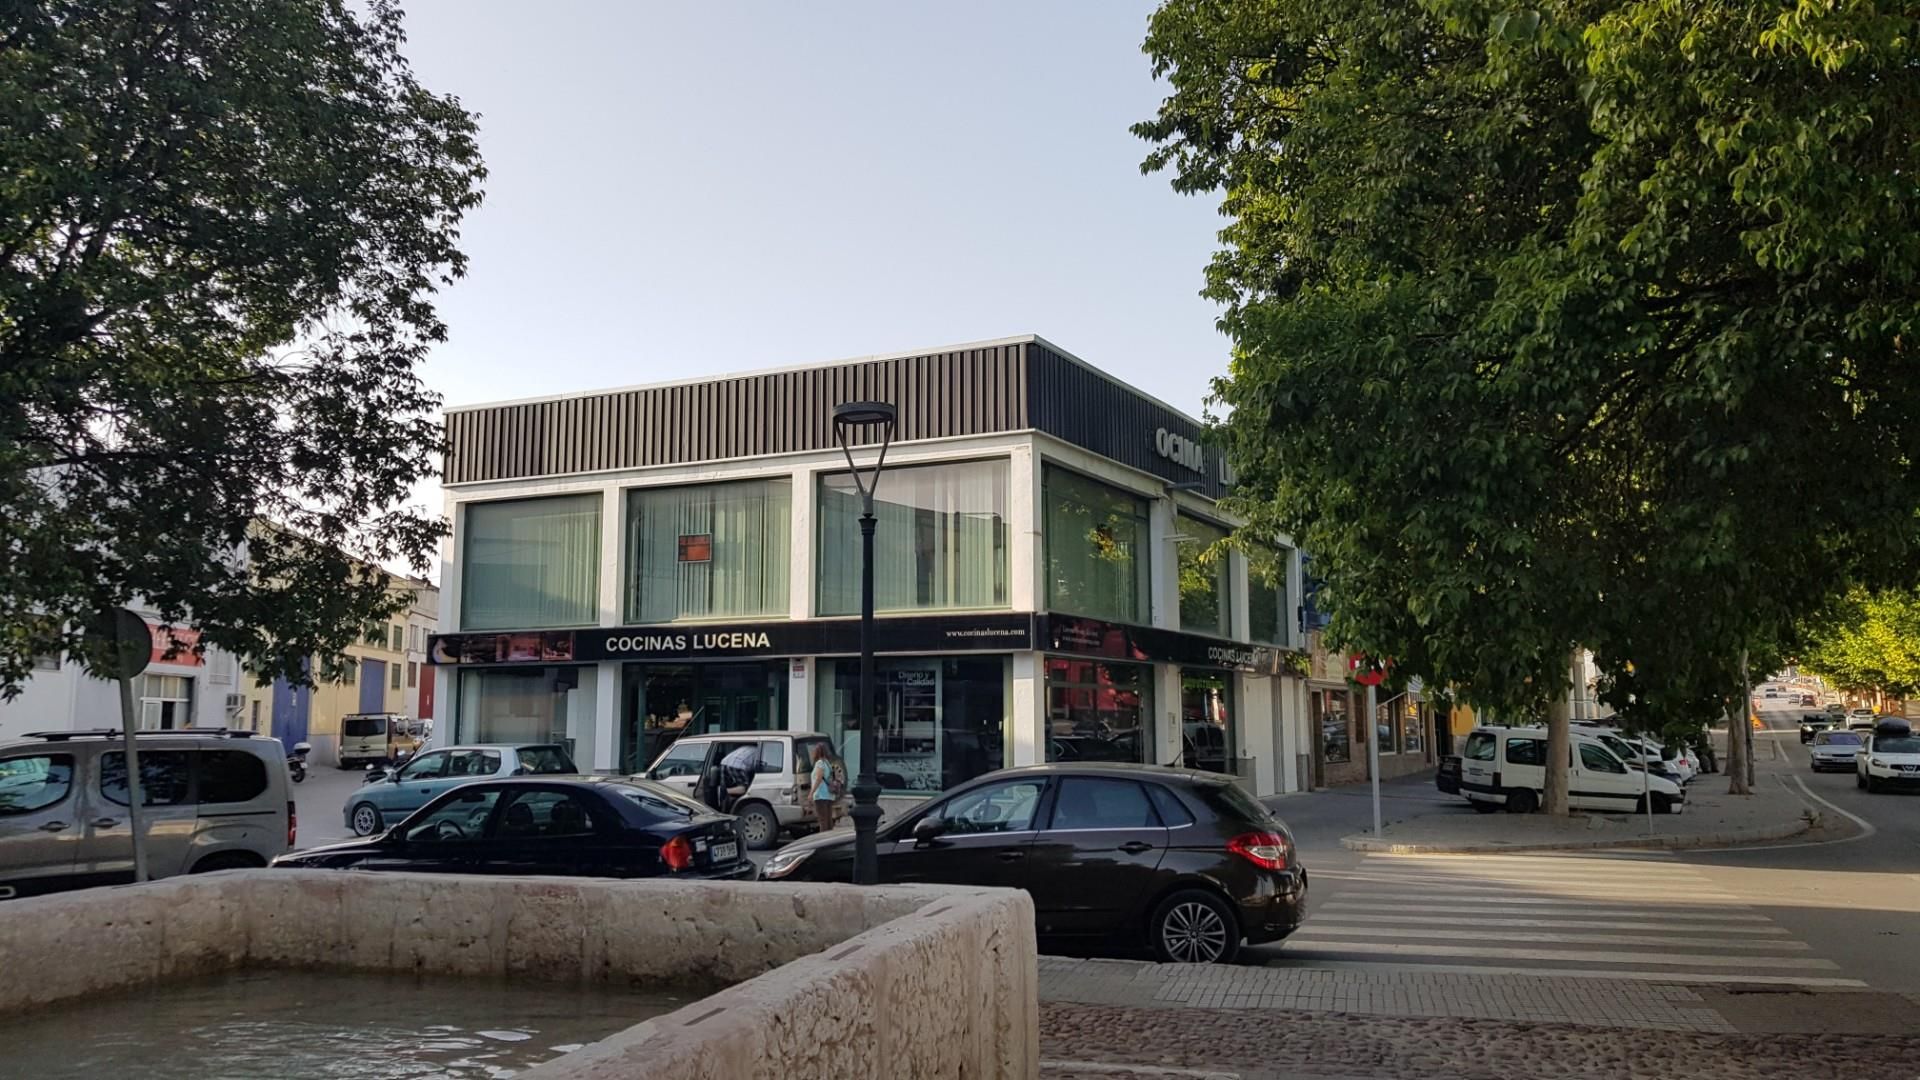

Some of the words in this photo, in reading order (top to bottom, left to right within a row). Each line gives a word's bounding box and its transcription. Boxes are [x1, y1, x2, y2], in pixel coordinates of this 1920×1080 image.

[945, 627, 1025, 637] www.cocinaslucena.com
[606, 635, 686, 651] COCINAS
[693, 632, 771, 649] LUCENA
[1208, 646, 1235, 663] COCINAS
